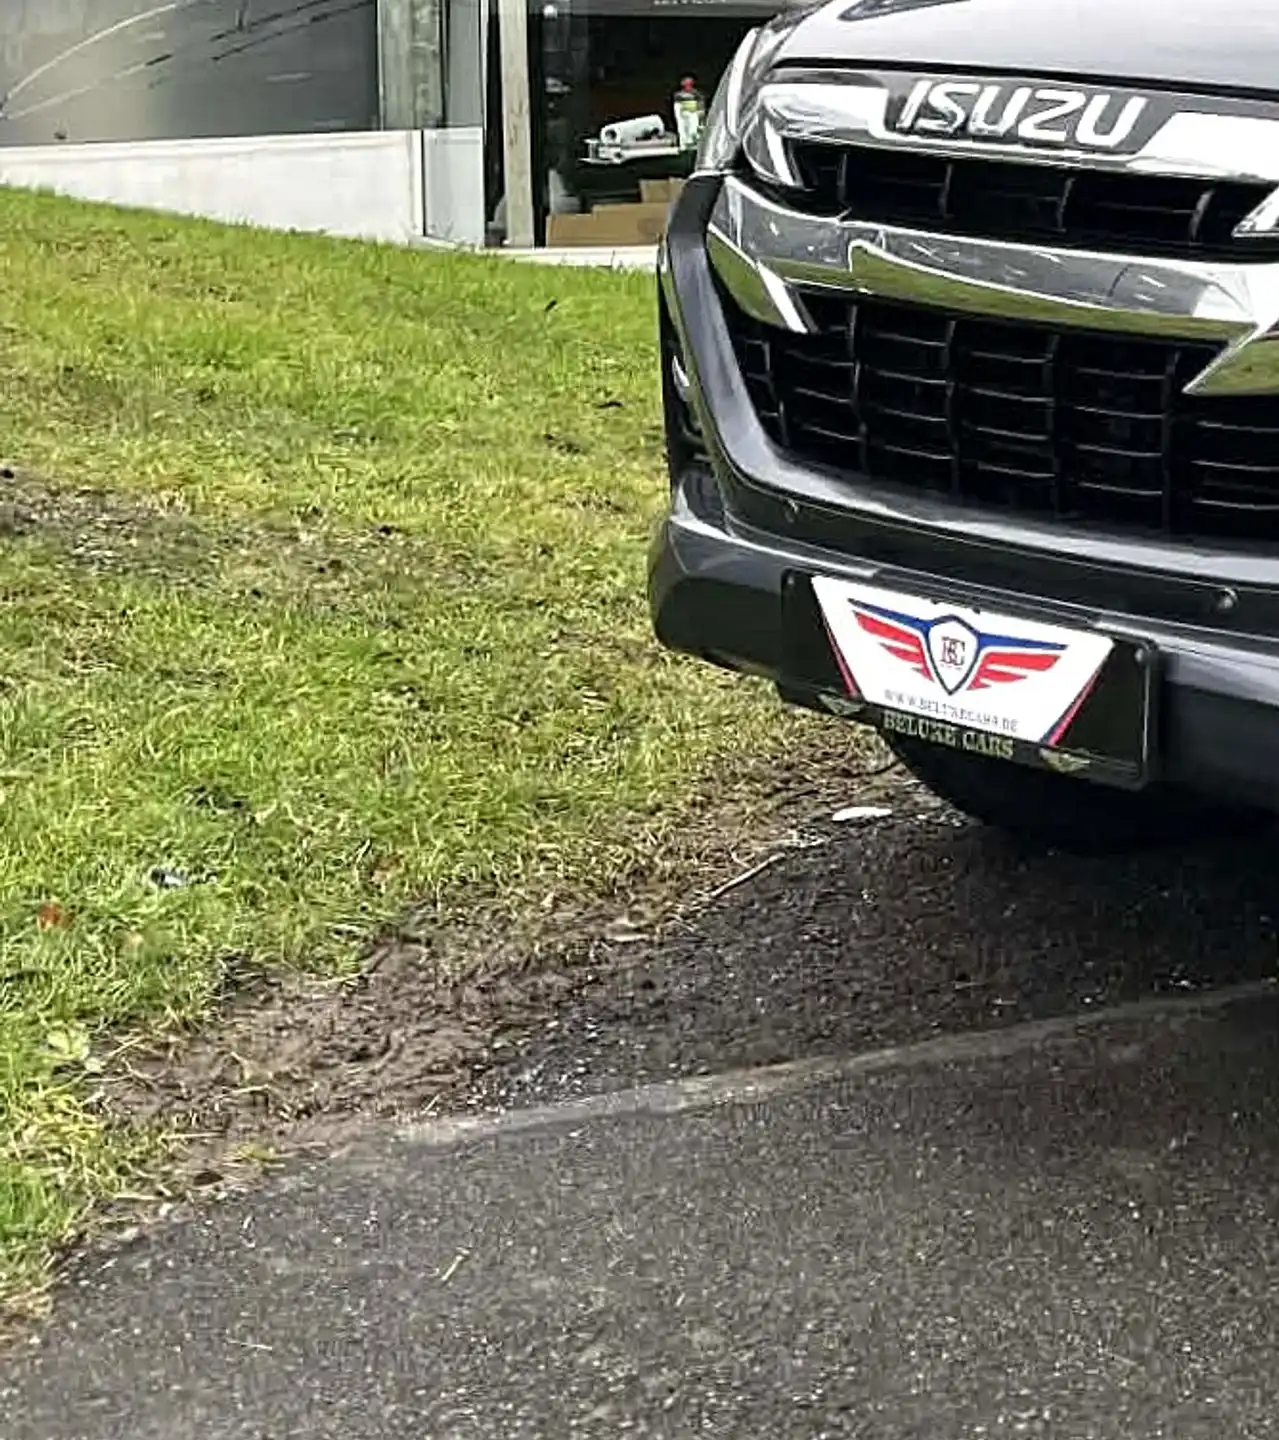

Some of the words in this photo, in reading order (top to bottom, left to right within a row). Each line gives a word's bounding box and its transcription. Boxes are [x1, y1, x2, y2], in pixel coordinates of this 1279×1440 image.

[895, 79, 1149, 148] ISUZU
[883, 709, 957, 746] BELUXE
[962, 730, 1014, 760] CARS
